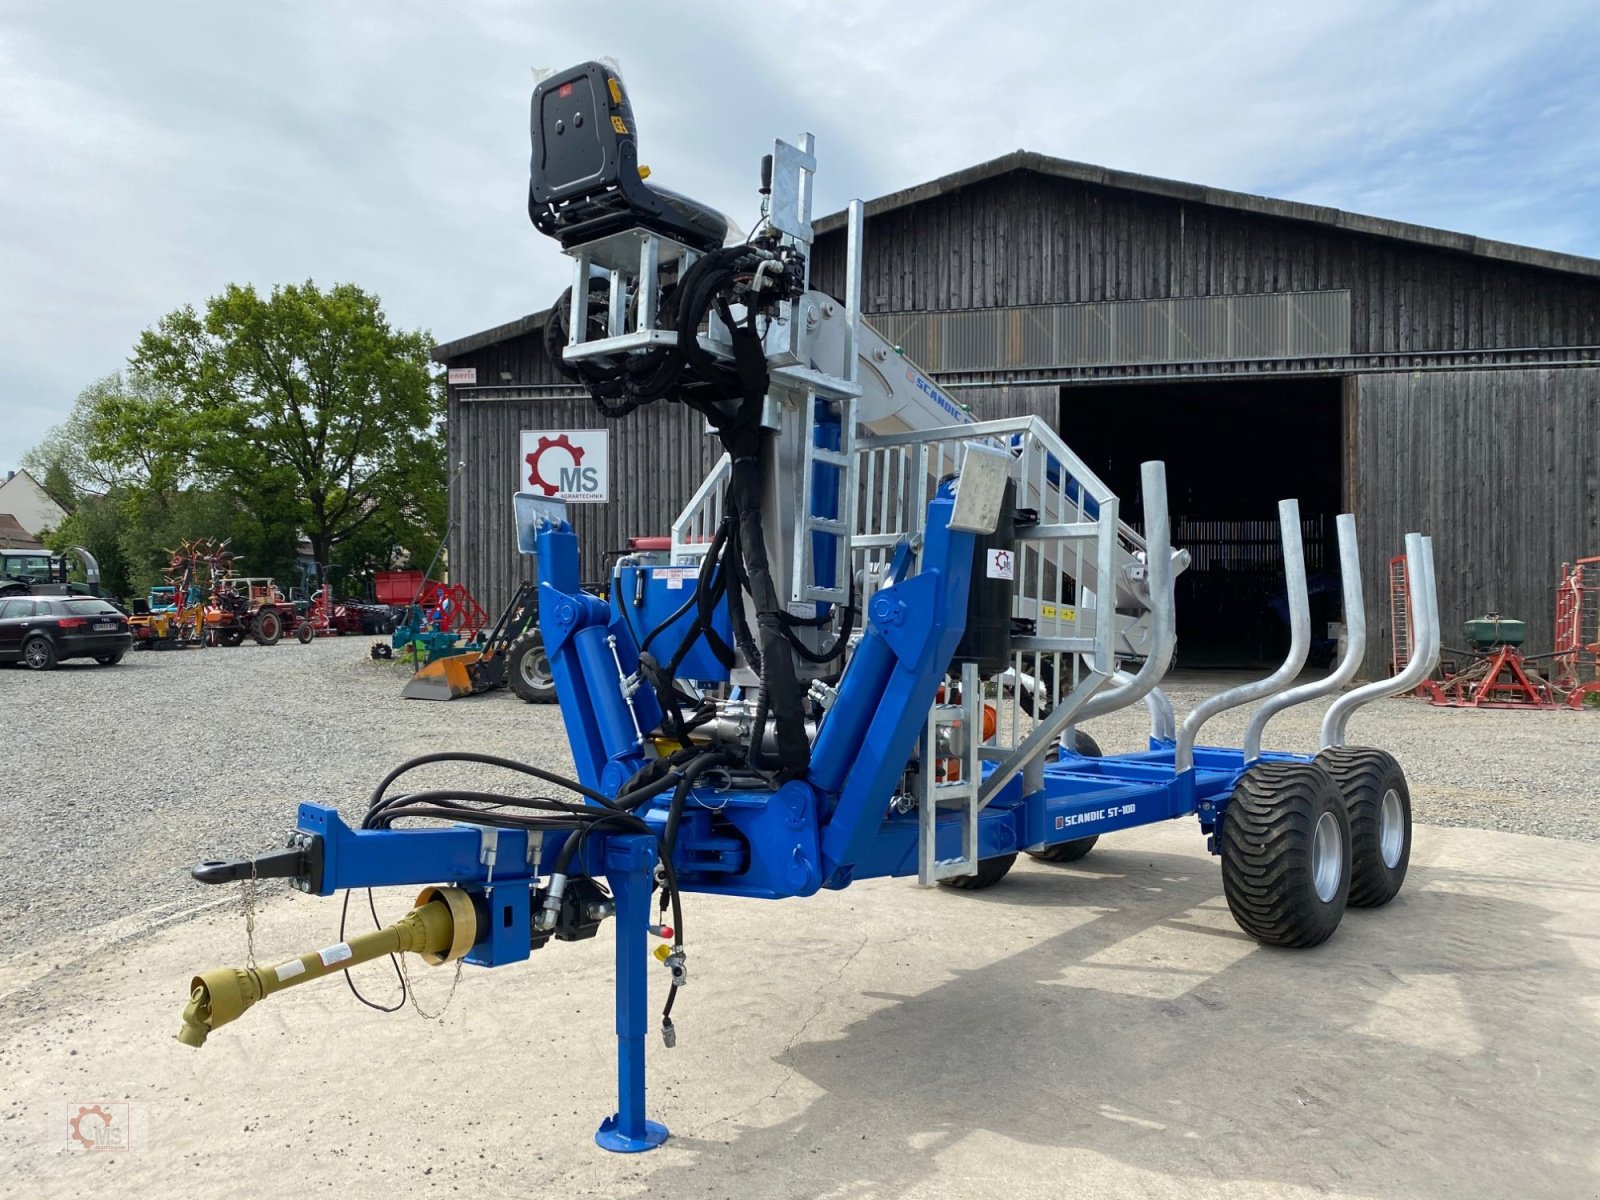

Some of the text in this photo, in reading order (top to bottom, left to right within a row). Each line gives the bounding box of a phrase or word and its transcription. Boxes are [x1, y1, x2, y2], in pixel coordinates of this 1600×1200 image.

[916, 378, 961, 422] SCANDIC
[1065, 804, 1136, 826] SCANDIC ST-100
